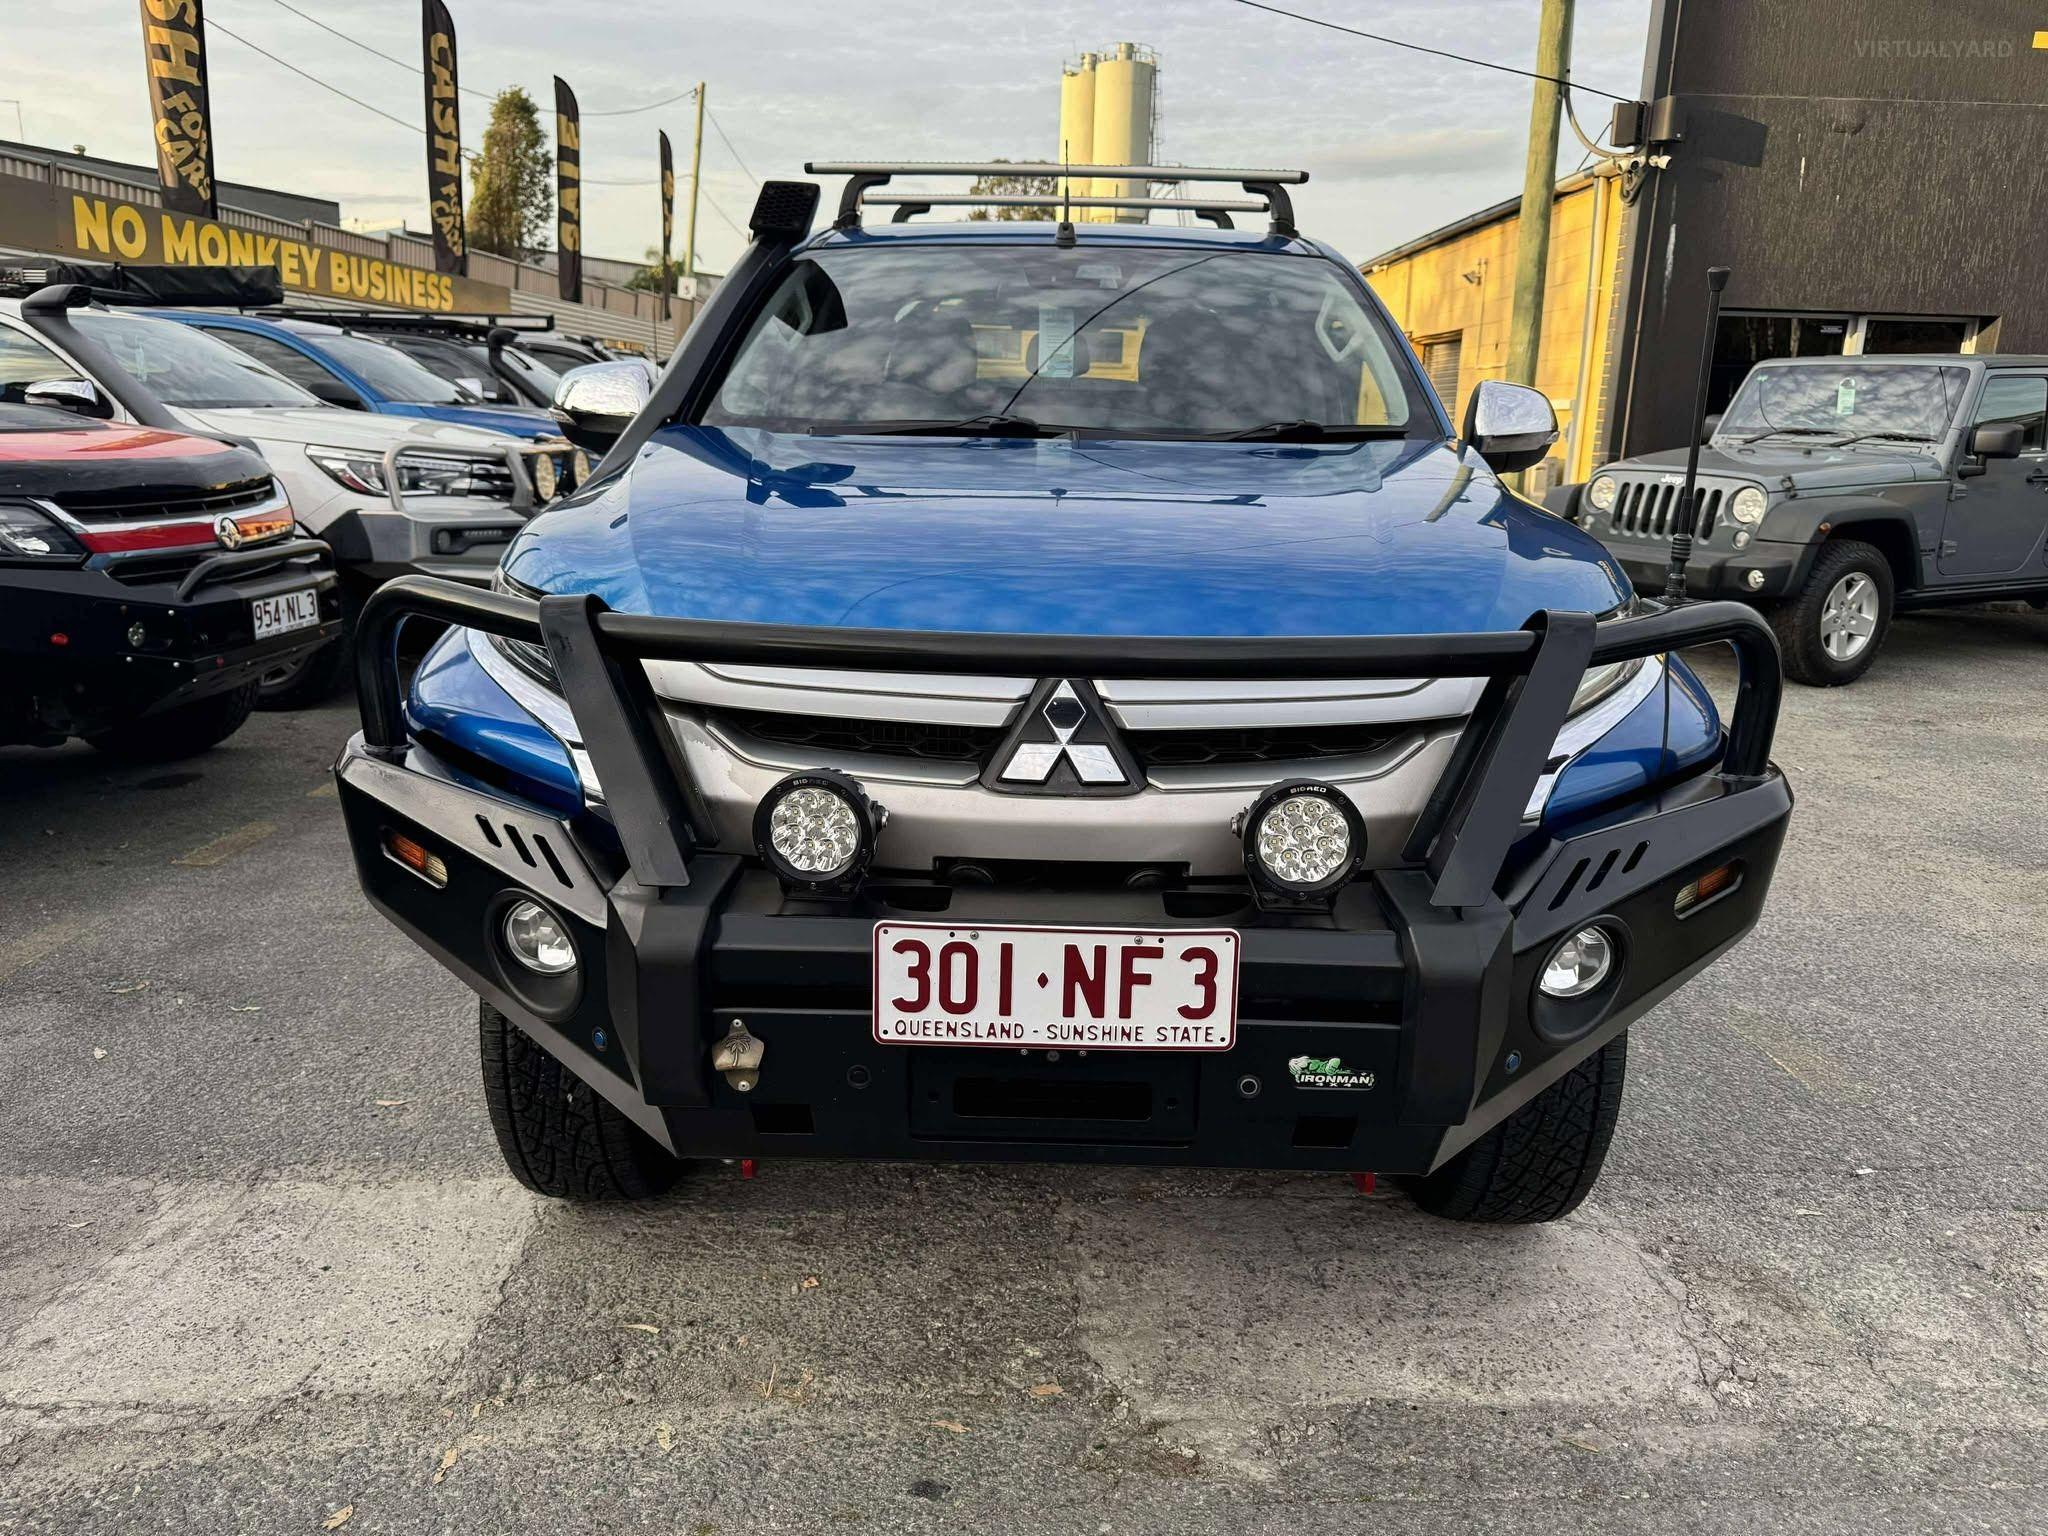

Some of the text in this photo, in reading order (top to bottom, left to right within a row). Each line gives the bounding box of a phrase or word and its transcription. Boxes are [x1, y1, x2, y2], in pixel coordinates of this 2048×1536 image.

[430, 32, 460, 176] CASH
[155, 118, 211, 201] CARS
[73, 196, 454, 312] NO MONKEY BUSINESS
[1661, 473, 1684, 486] Jeep
[895, 1020, 1025, 1039] QUEENSLAND
[1047, 1023, 1144, 1042] SUNSHINE
[1156, 1026, 1214, 1043] STATE
[1300, 1074, 1370, 1084] IRONMAN
